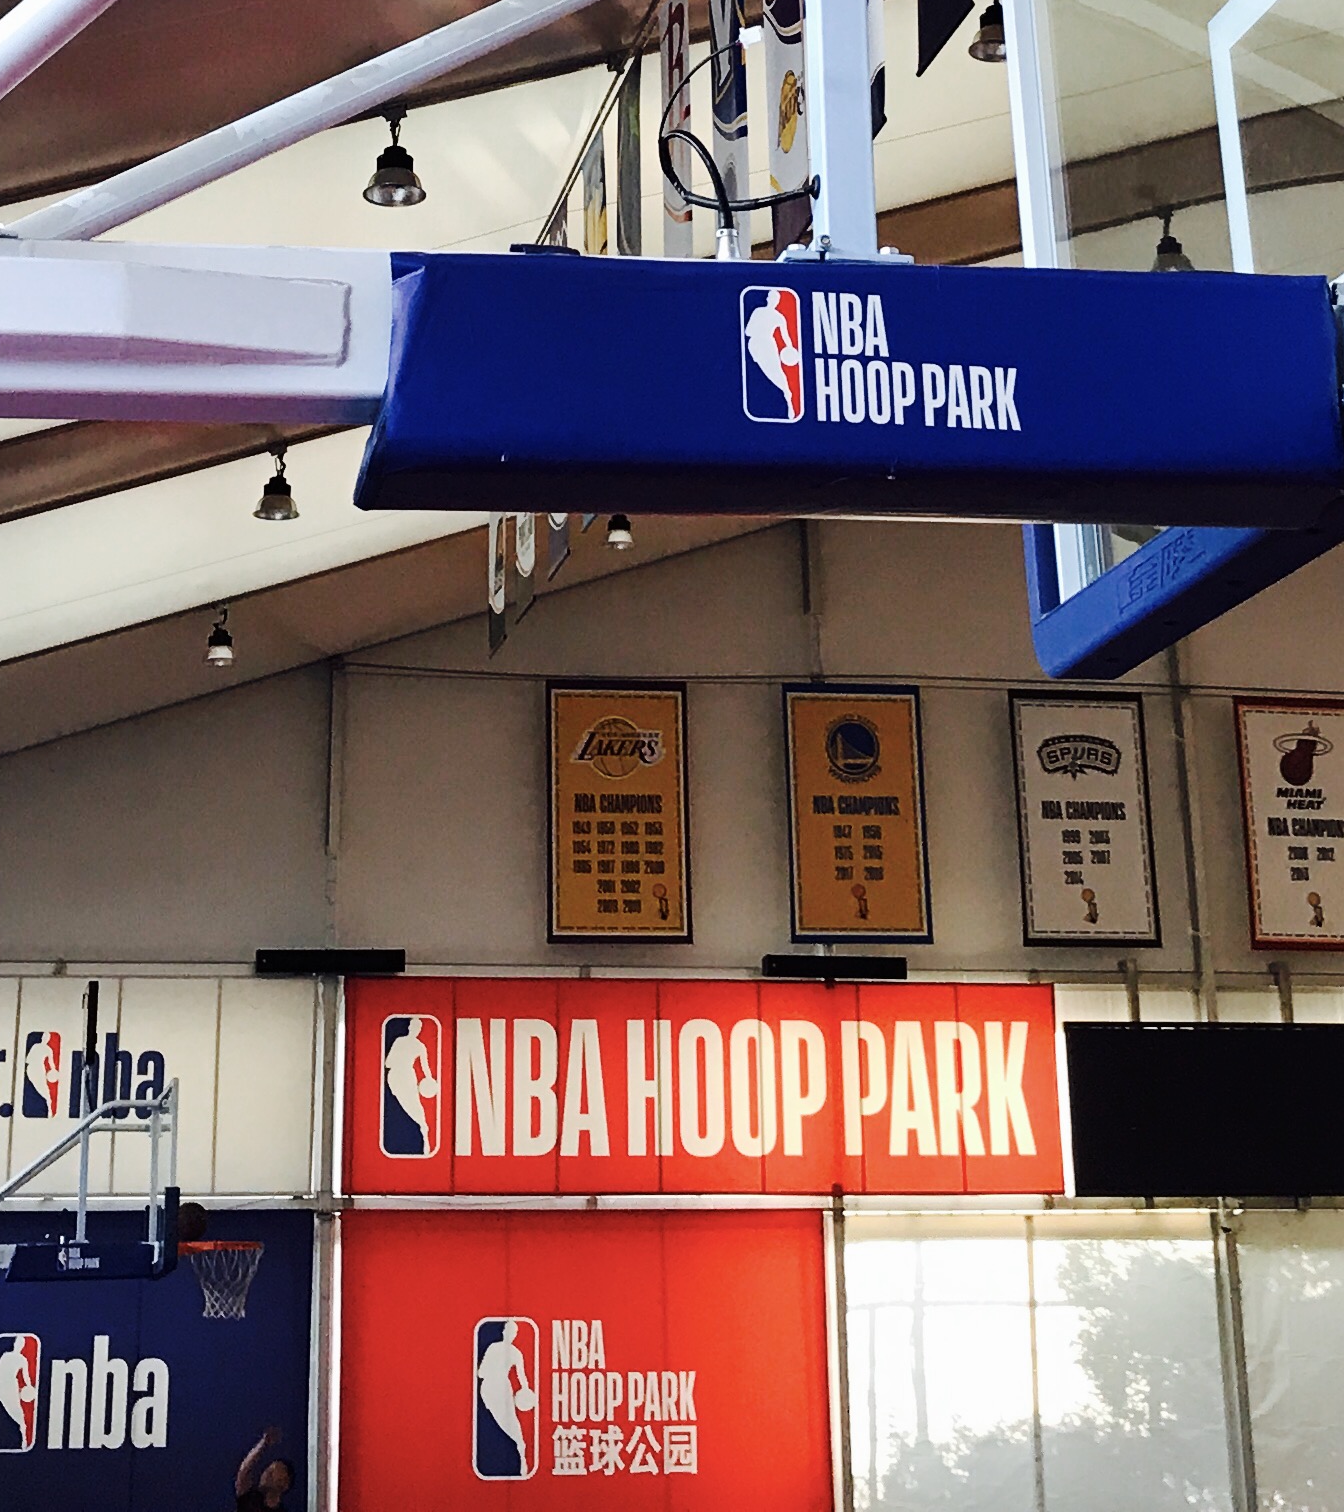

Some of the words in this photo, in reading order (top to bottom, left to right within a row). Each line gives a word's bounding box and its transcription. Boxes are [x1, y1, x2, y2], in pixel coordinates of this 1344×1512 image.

[812, 291, 890, 358] NBA
[814, 358, 916, 425] HOOP
[921, 363, 1022, 431] PARK
[1046, 747, 1113, 768] SPURS
[574, 793, 596, 813] NBA
[600, 794, 663, 814] CHAMPIONS
[813, 795, 835, 814] NBA
[838, 796, 900, 816] CHAMPIONS
[1041, 800, 1064, 819] NBA
[1066, 801, 1126, 820] CHAMPIONS
[1276, 788, 1323, 799] MIAMI
[1286, 798, 1327, 810] HEAT
[1267, 817, 1290, 836] NBA
[68, 1032, 165, 1120] nba
[456, 1018, 610, 1157] NBA
[627, 1019, 827, 1157] HOOP
[840, 1020, 1037, 1157] PARK
[552, 1320, 605, 1369] NBA
[47, 1335, 169, 1449] nba
[552, 1371, 623, 1423] HOOP
[628, 1371, 697, 1422] PARK
[552, 1425, 698, 1475] 篮球公园
